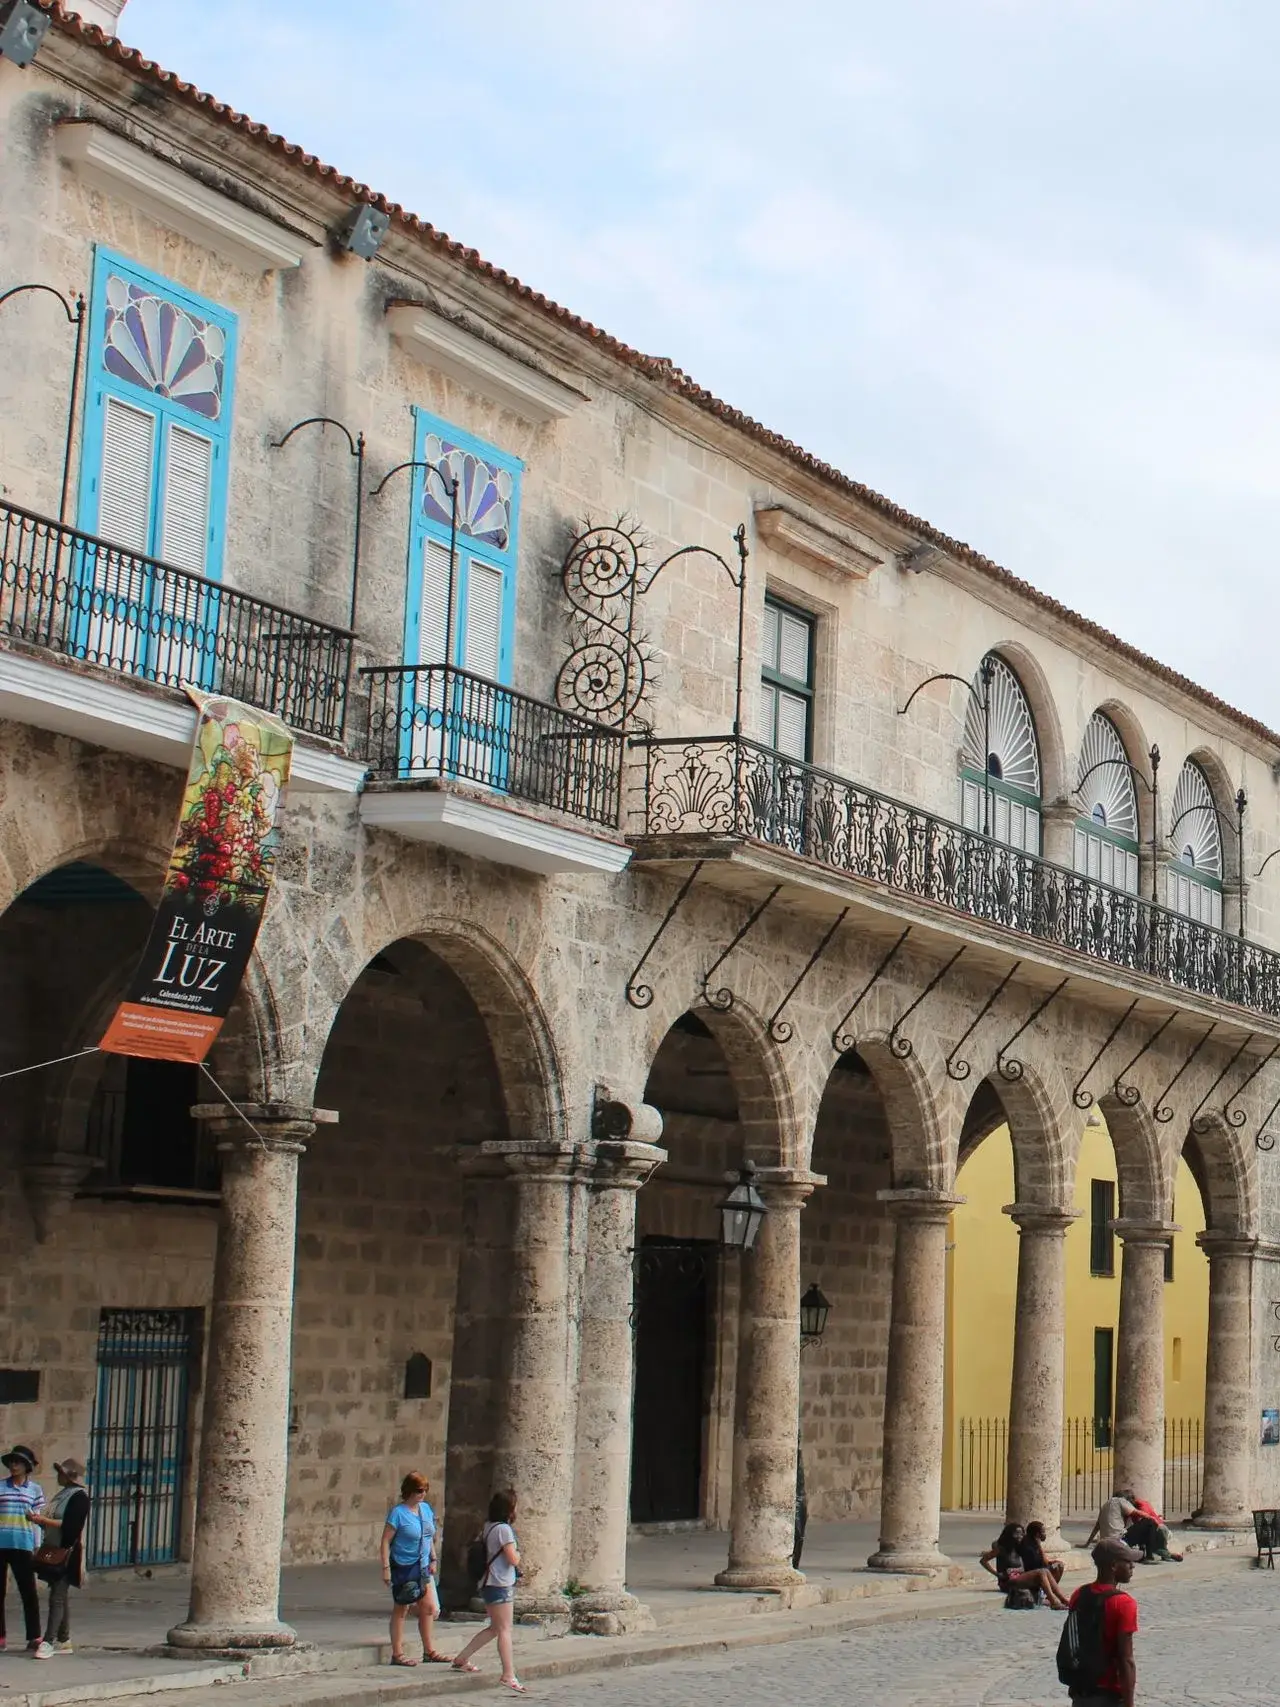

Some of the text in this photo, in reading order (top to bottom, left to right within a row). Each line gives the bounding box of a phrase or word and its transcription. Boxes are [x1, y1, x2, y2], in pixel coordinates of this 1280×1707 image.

[152, 940, 227, 992] LUZ
[159, 989, 202, 1003] Calendario 2017
